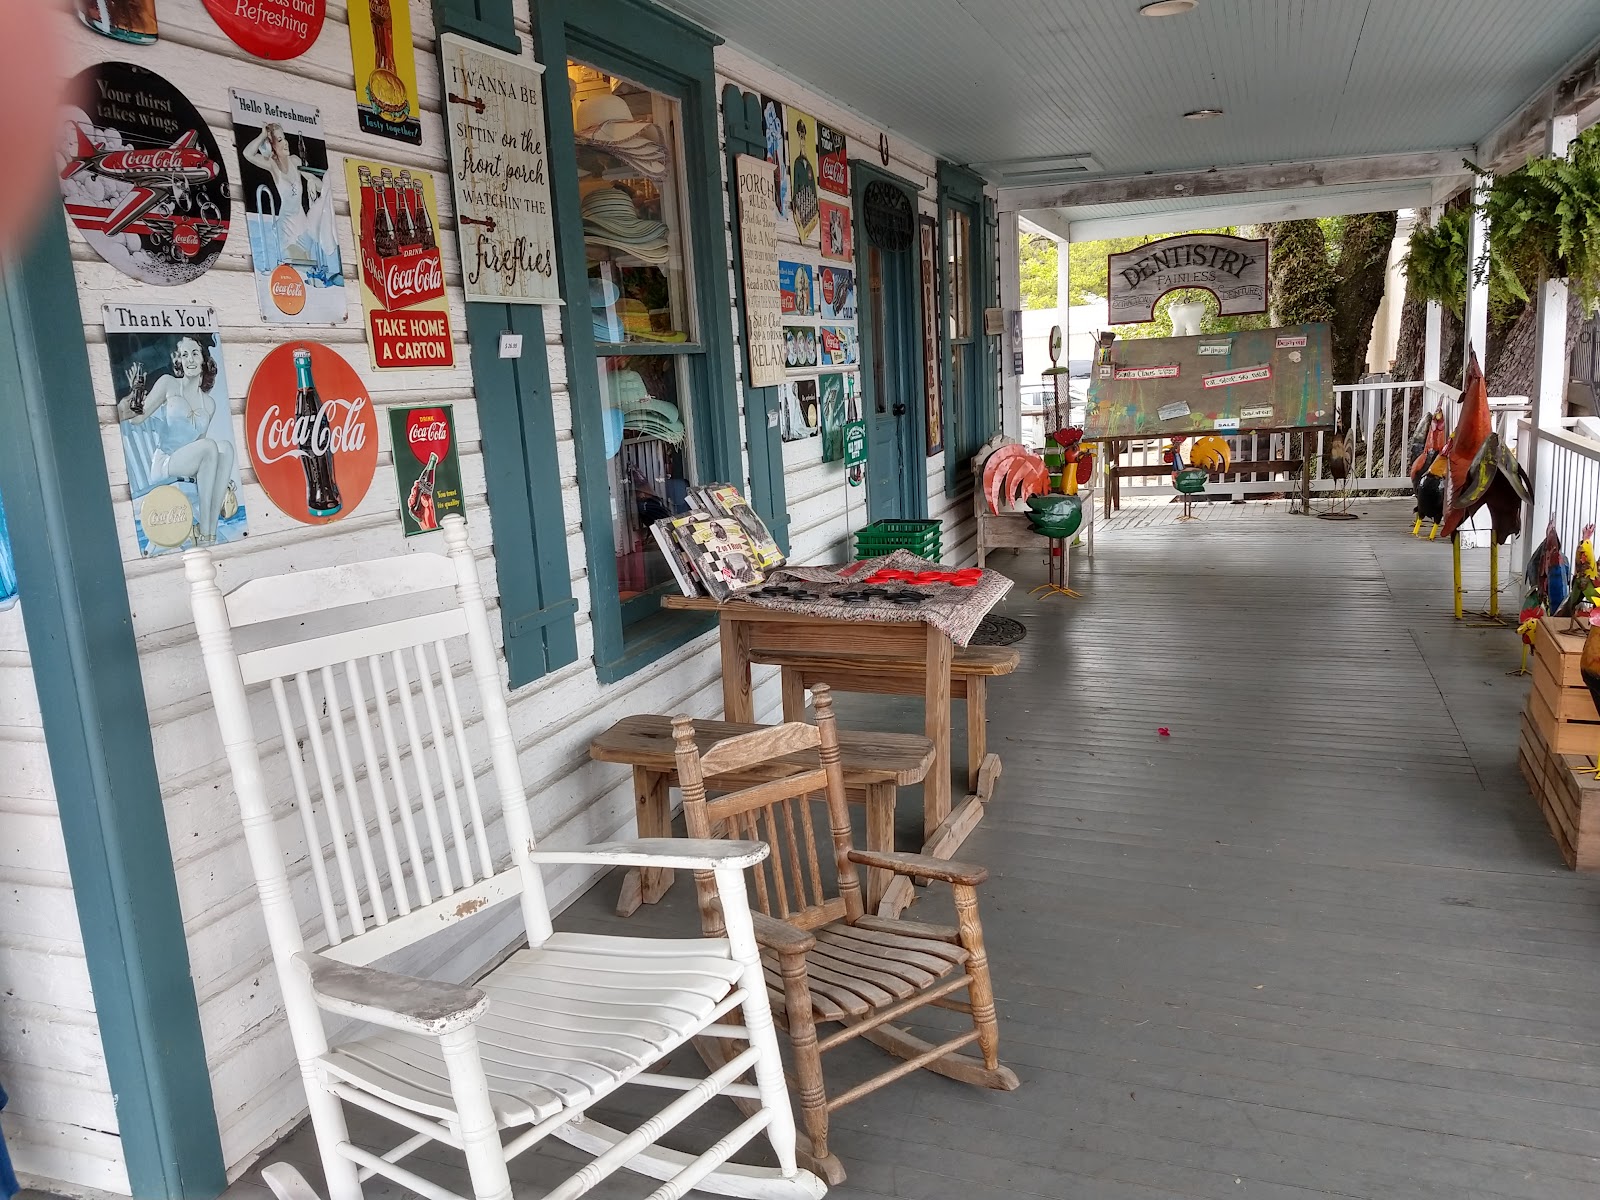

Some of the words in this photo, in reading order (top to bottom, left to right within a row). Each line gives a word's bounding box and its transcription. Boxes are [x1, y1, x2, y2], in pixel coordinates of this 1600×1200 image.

[234, 0, 308, 39] Refreshing
[96, 79, 132, 104] Your
[135, 91, 172, 113] thirst
[452, 65, 457, 83] I
[459, 67, 518, 99] WANNA
[520, 86, 537, 105] BE
[97, 104, 136, 123] takes
[139, 112, 179, 134] wings
[364, 114, 384, 132] Tasty
[386, 122, 419, 137] together!
[501, 132, 518, 149] on
[520, 128, 542, 155] the
[121, 150, 183, 169] Coca-Cola
[458, 147, 502, 181] front
[501, 159, 545, 192] porch
[739, 173, 775, 202] PORCH
[524, 199, 546, 214] THE
[749, 195, 768, 211] RULES
[742, 227, 757, 245] Take
[758, 230, 764, 246] A
[765, 231, 778, 252] Nap
[403, 248, 423, 258] DRINK
[468, 233, 552, 286] fireflies
[361, 247, 384, 286] Coke
[387, 256, 442, 299] Coca-Cola
[1119, 243, 1257, 290] DENTISTRY
[1156, 270, 1217, 286] PAINLESS
[272, 281, 302, 297] Coca-Cola
[746, 276, 760, 290] Read
[764, 279, 780, 292] BOOK
[1222, 286, 1264, 301] DENTURES
[114, 307, 173, 327] Thank
[175, 309, 212, 327] You!
[375, 318, 408, 336] TAKE
[410, 318, 446, 336] HOME
[767, 330, 783, 341] DRINK
[383, 342, 393, 360] A
[395, 341, 446, 359] CARTON
[751, 344, 784, 368] RELAX
[256, 396, 366, 464] Coca-Cola
[409, 421, 447, 443] Coca-Cola
